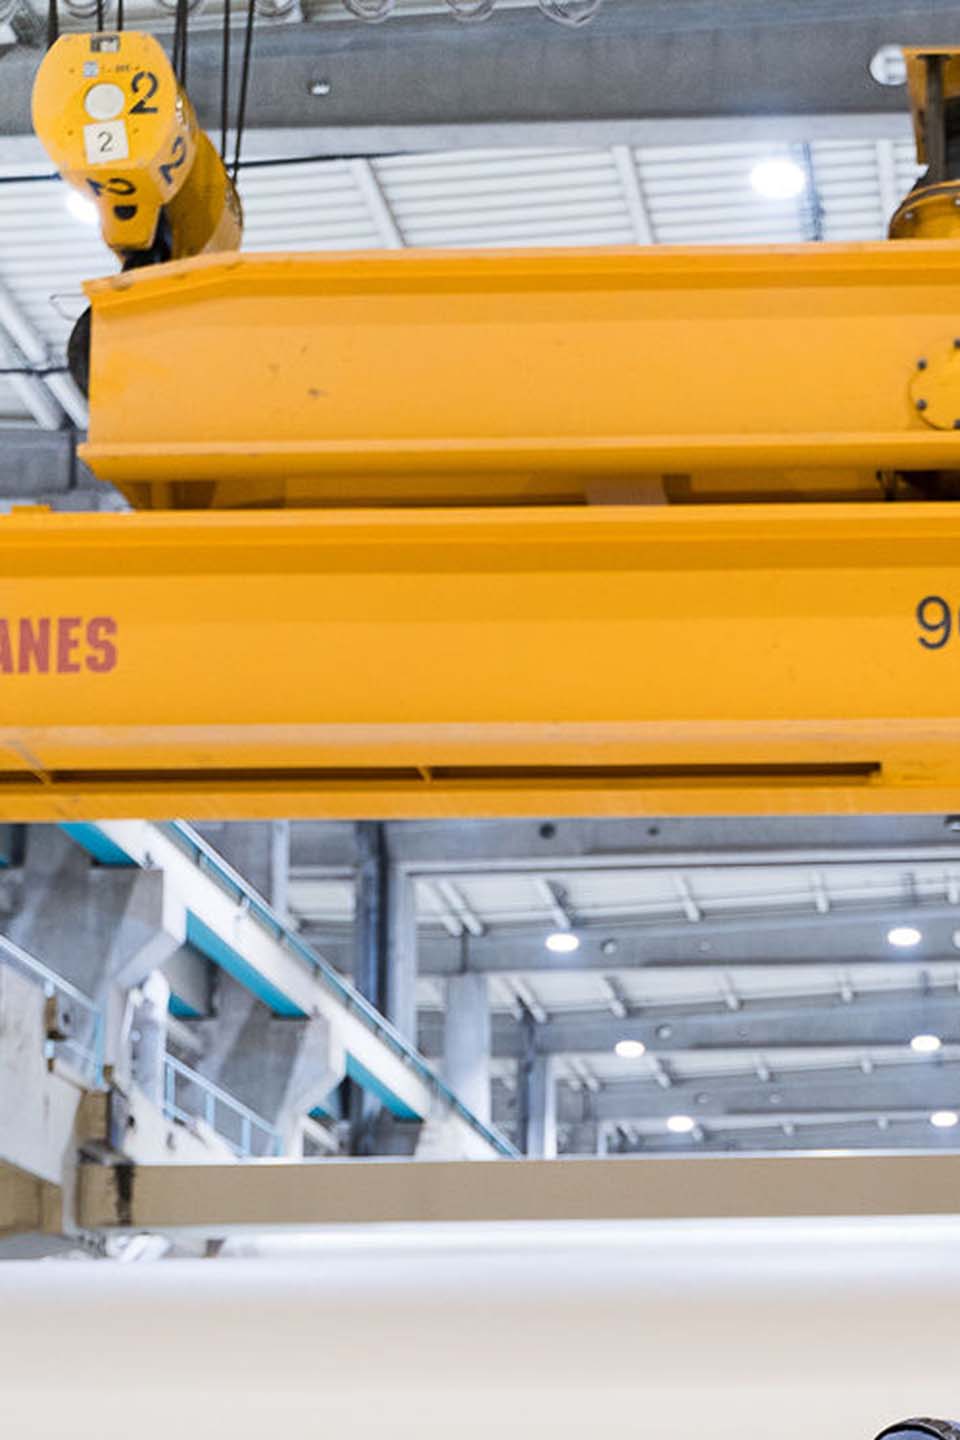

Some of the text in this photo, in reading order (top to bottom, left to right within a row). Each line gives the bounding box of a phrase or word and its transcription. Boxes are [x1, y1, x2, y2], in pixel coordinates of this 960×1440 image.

[129, 71, 159, 114] 2
[98, 131, 113, 152] 2
[159, 136, 187, 185] 2
